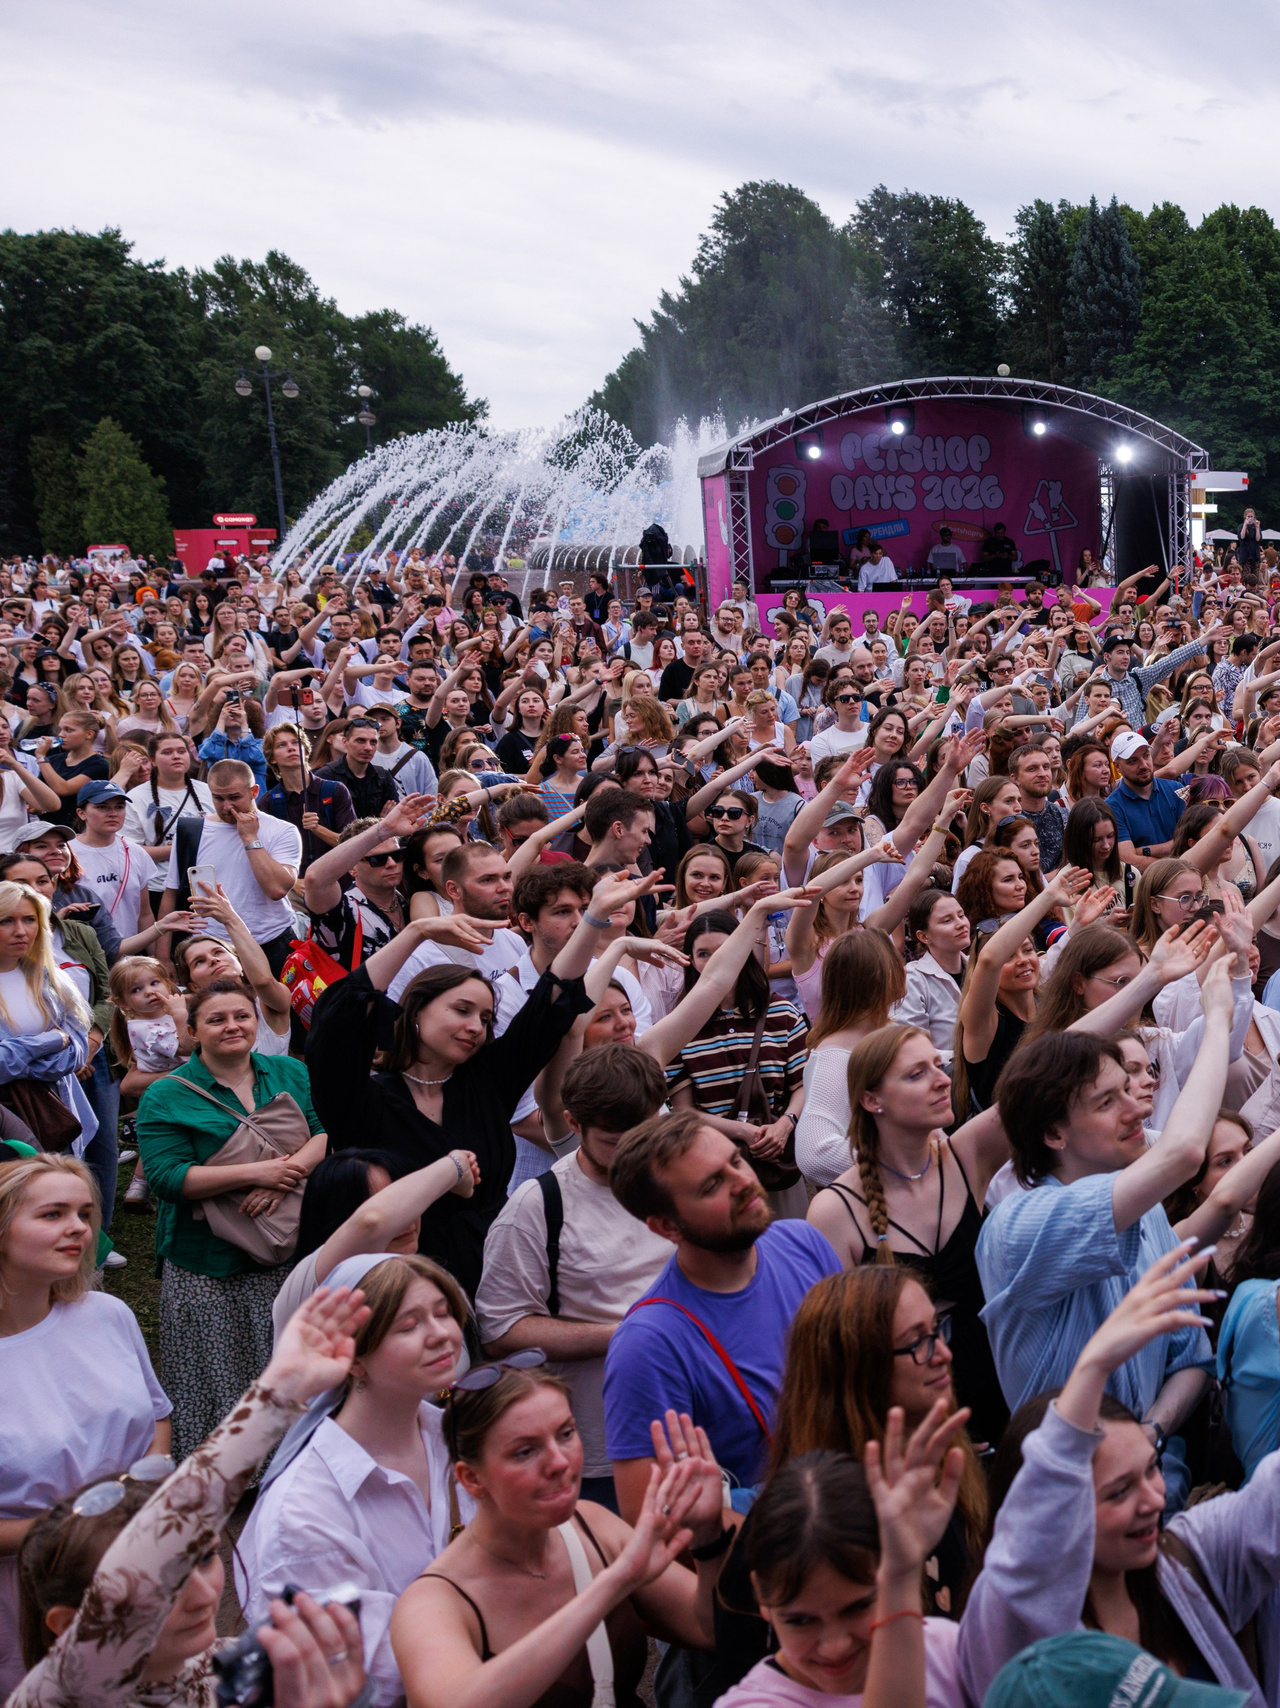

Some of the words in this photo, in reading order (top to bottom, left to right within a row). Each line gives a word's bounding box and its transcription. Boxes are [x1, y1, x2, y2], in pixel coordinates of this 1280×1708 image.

[840, 432, 991, 473] PETSHOP
[830, 474, 917, 511] DAYS
[921, 474, 1005, 511] 2026
